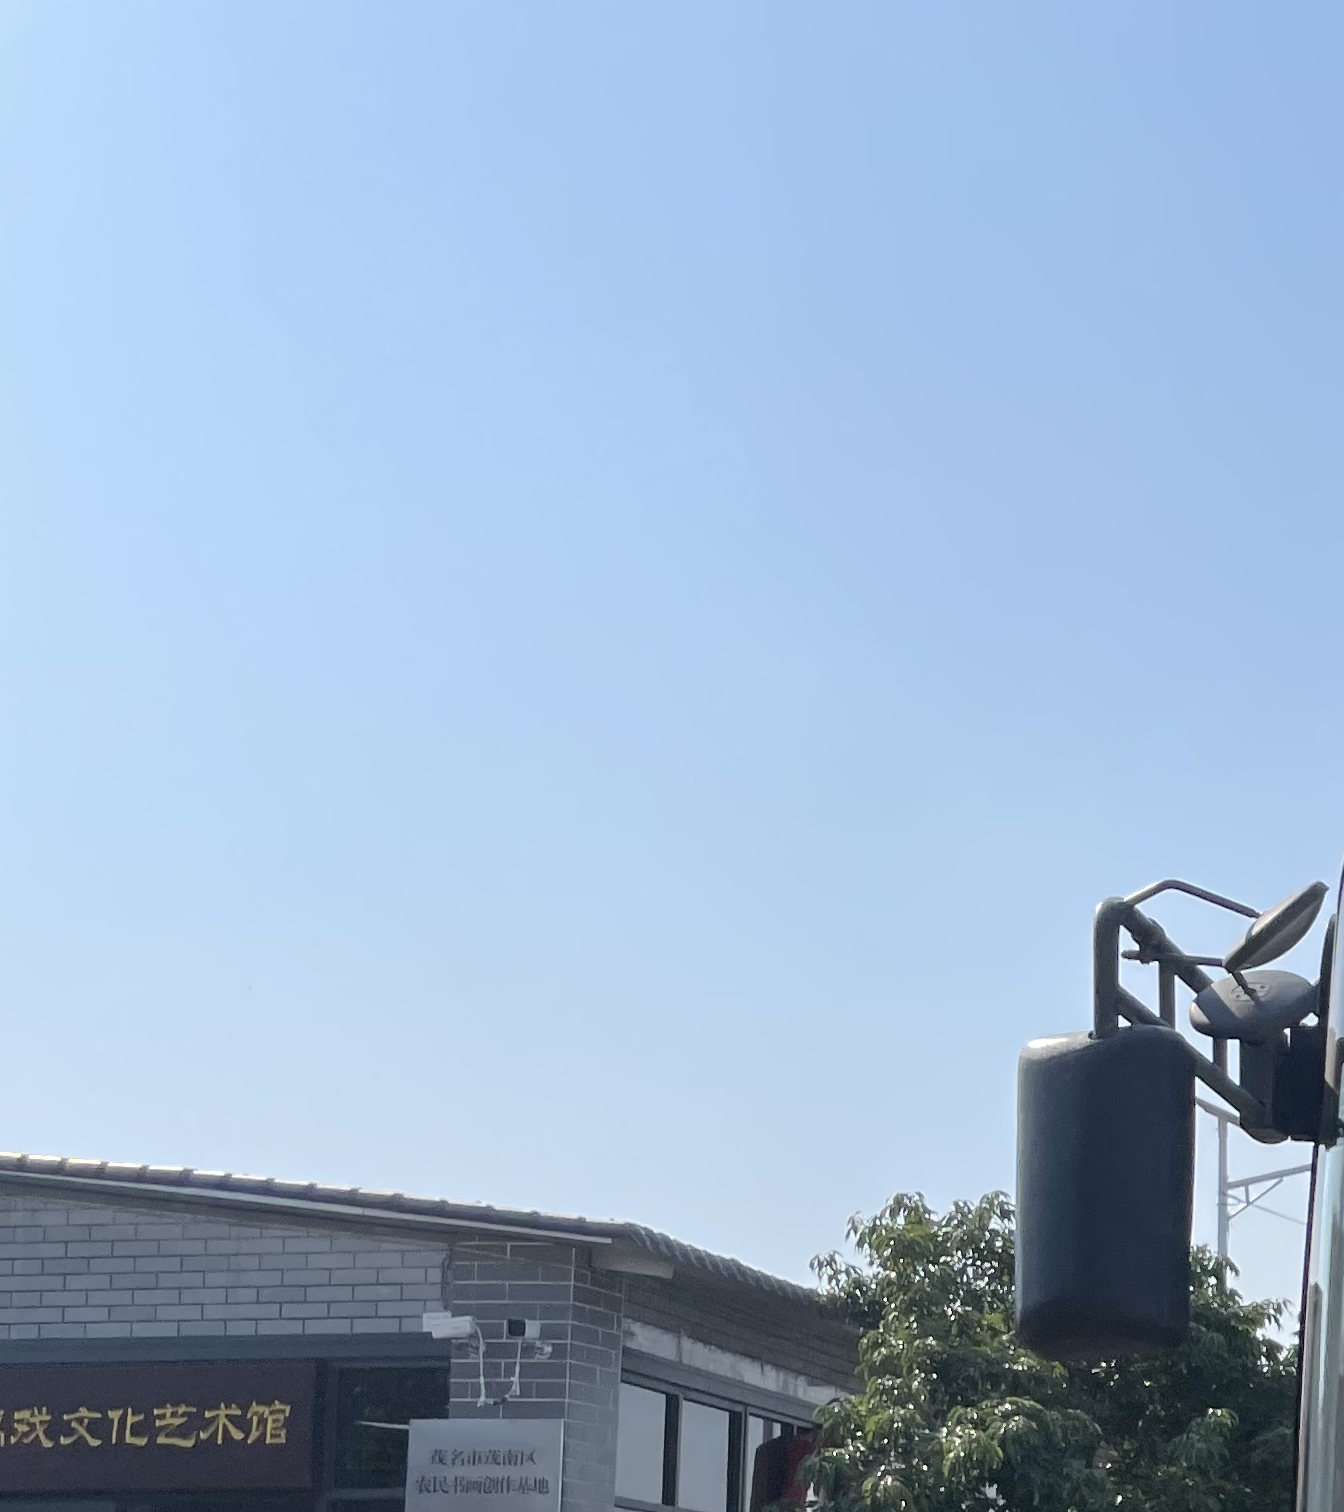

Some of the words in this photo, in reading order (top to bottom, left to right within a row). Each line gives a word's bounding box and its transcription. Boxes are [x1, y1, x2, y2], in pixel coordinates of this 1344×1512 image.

[0, 1399, 292, 1448] 戏文化艺术馆
